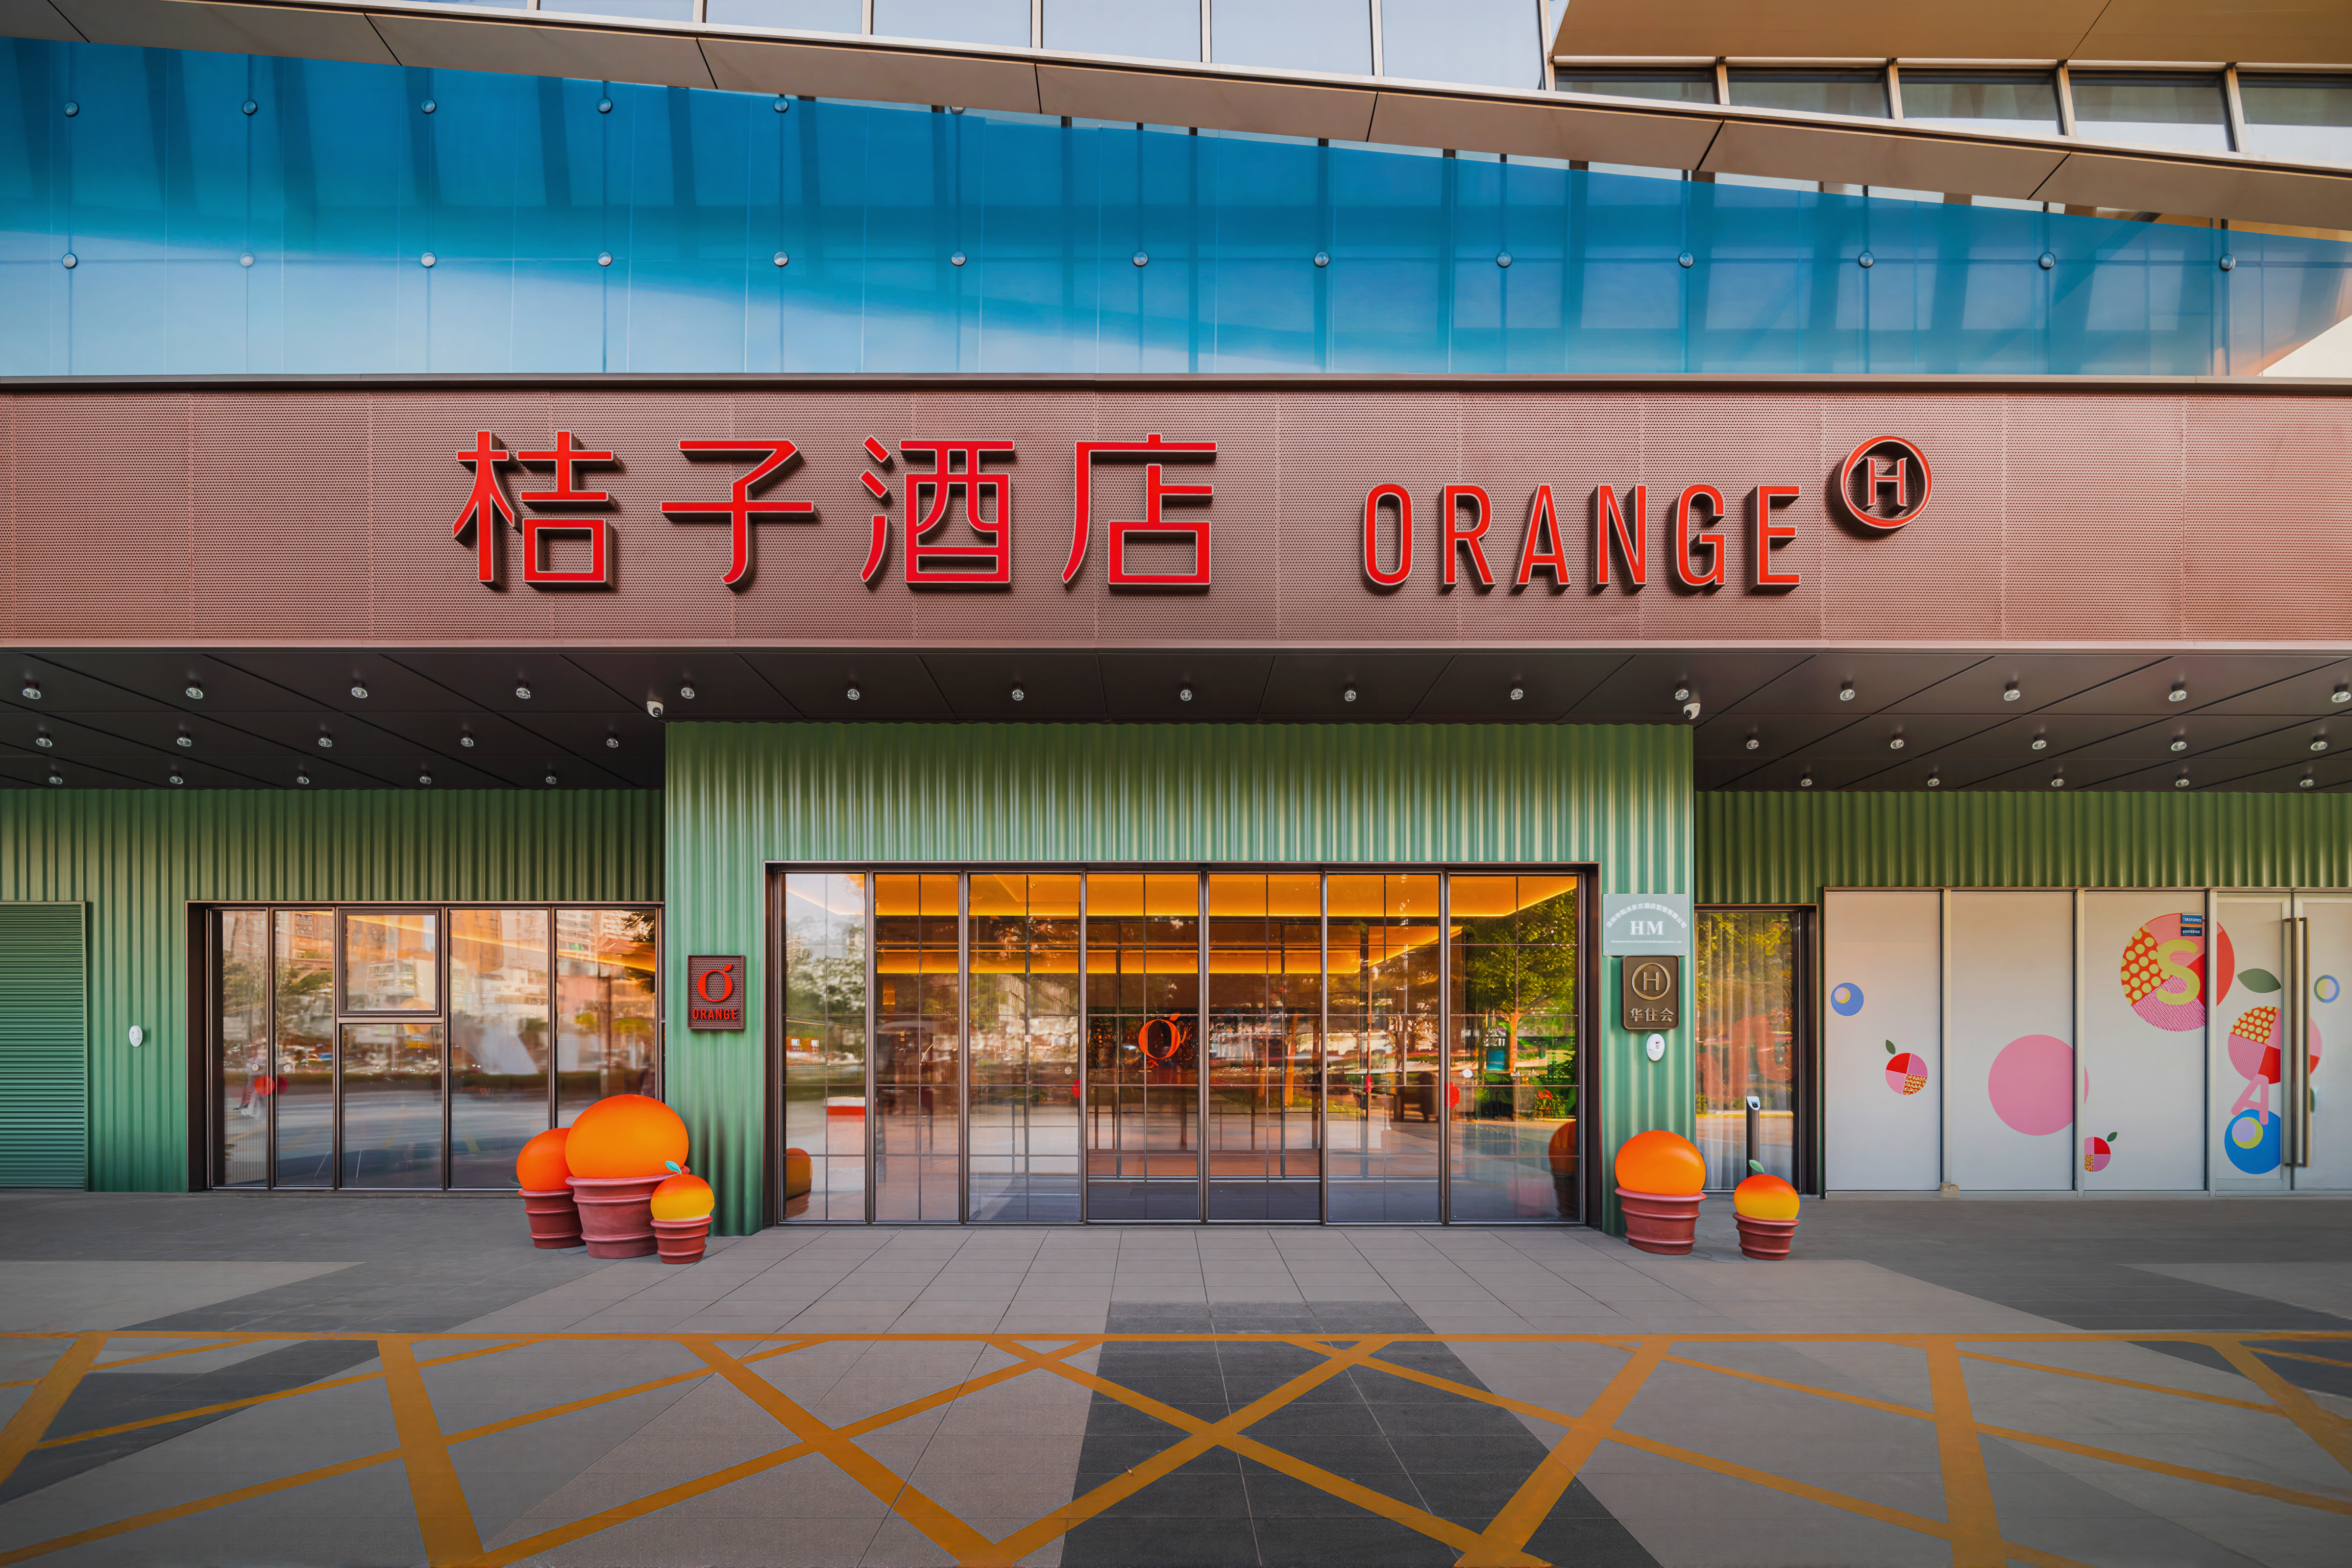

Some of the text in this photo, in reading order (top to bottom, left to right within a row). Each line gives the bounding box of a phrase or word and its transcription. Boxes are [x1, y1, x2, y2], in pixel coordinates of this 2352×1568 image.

[451, 429, 1219, 586] 桔子酒店
[1862, 456, 1908, 513] H
[1364, 483, 1801, 586] ORANGE
[1630, 921, 1664, 935] HM
[1643, 972, 1660, 991] H
[2156, 939, 2201, 1005] S
[692, 1008, 737, 1020] ORANGE
[1630, 1007, 1674, 1022] 华住会
[2230, 1074, 2269, 1125] A
